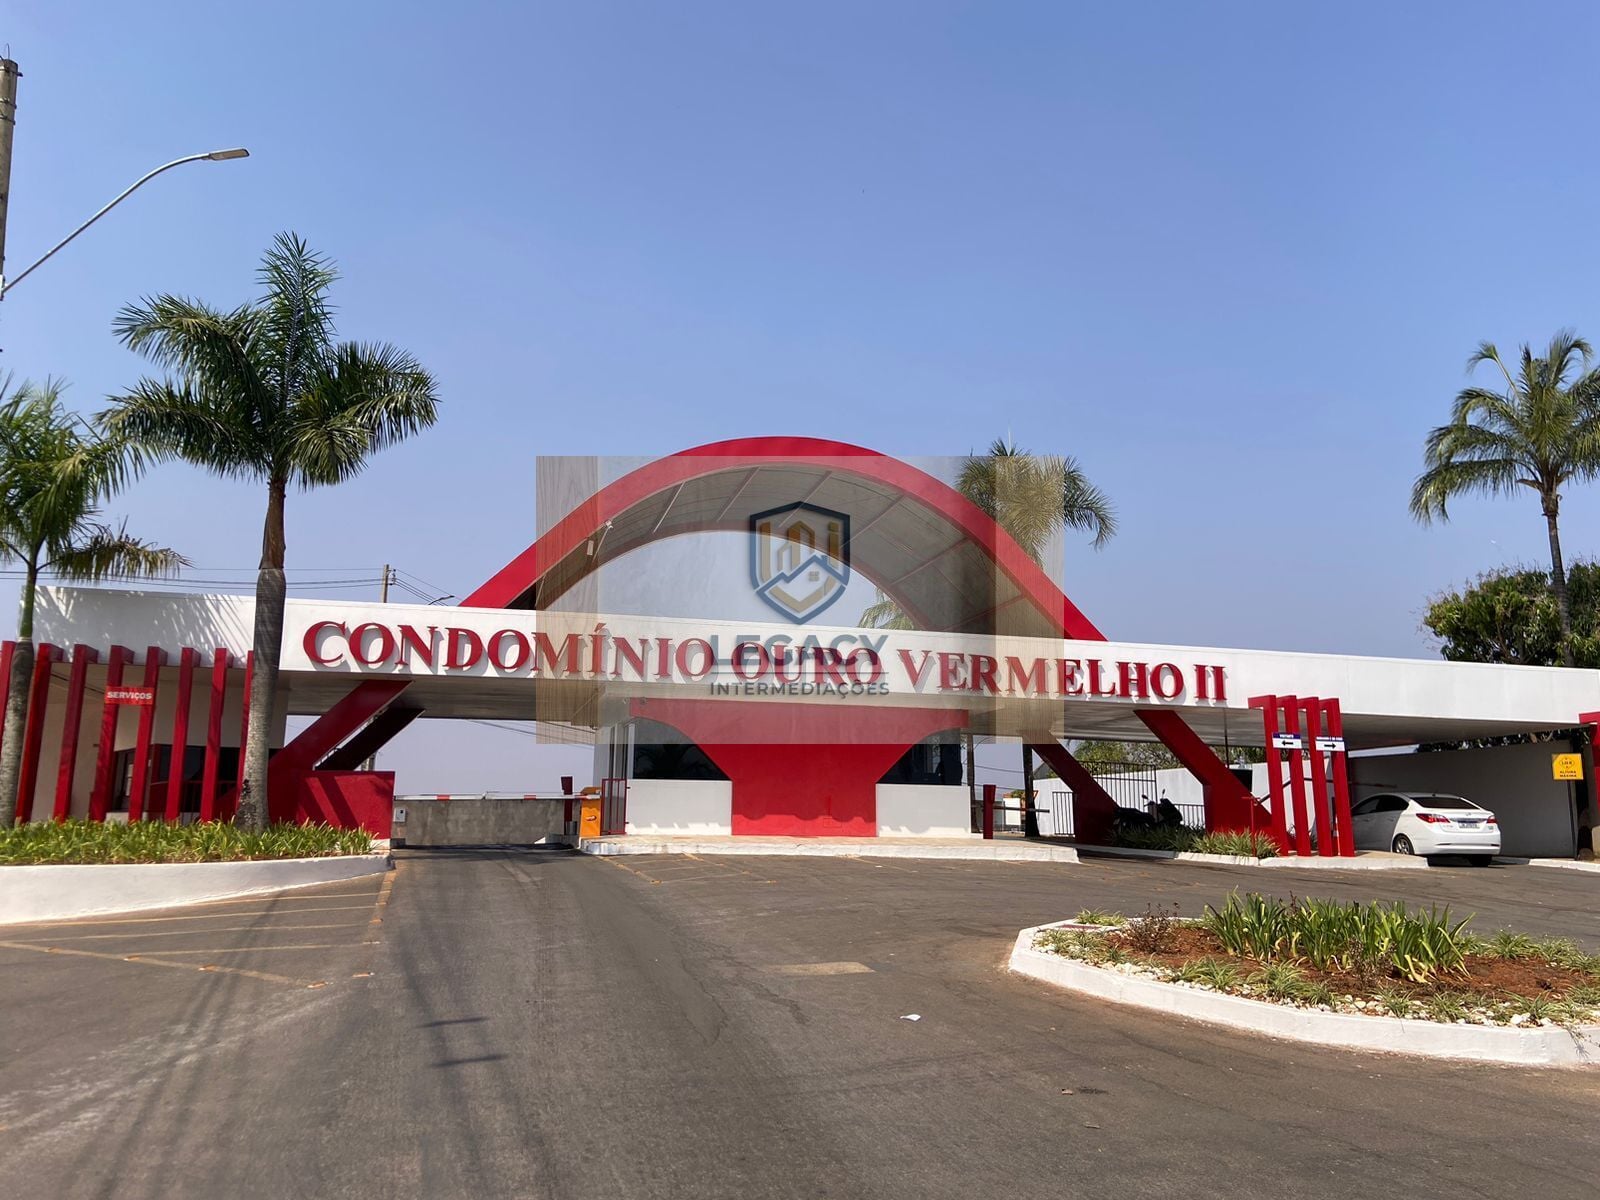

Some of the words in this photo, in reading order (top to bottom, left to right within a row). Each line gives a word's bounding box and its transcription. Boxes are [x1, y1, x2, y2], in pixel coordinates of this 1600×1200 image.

[302, 620, 715, 678] CONDOMÍNIO
[731, 641, 882, 685] OURO
[896, 648, 1185, 699] VERMELHO
[1193, 664, 1228, 701] II
[106, 691, 153, 701] SERVIÇOS
